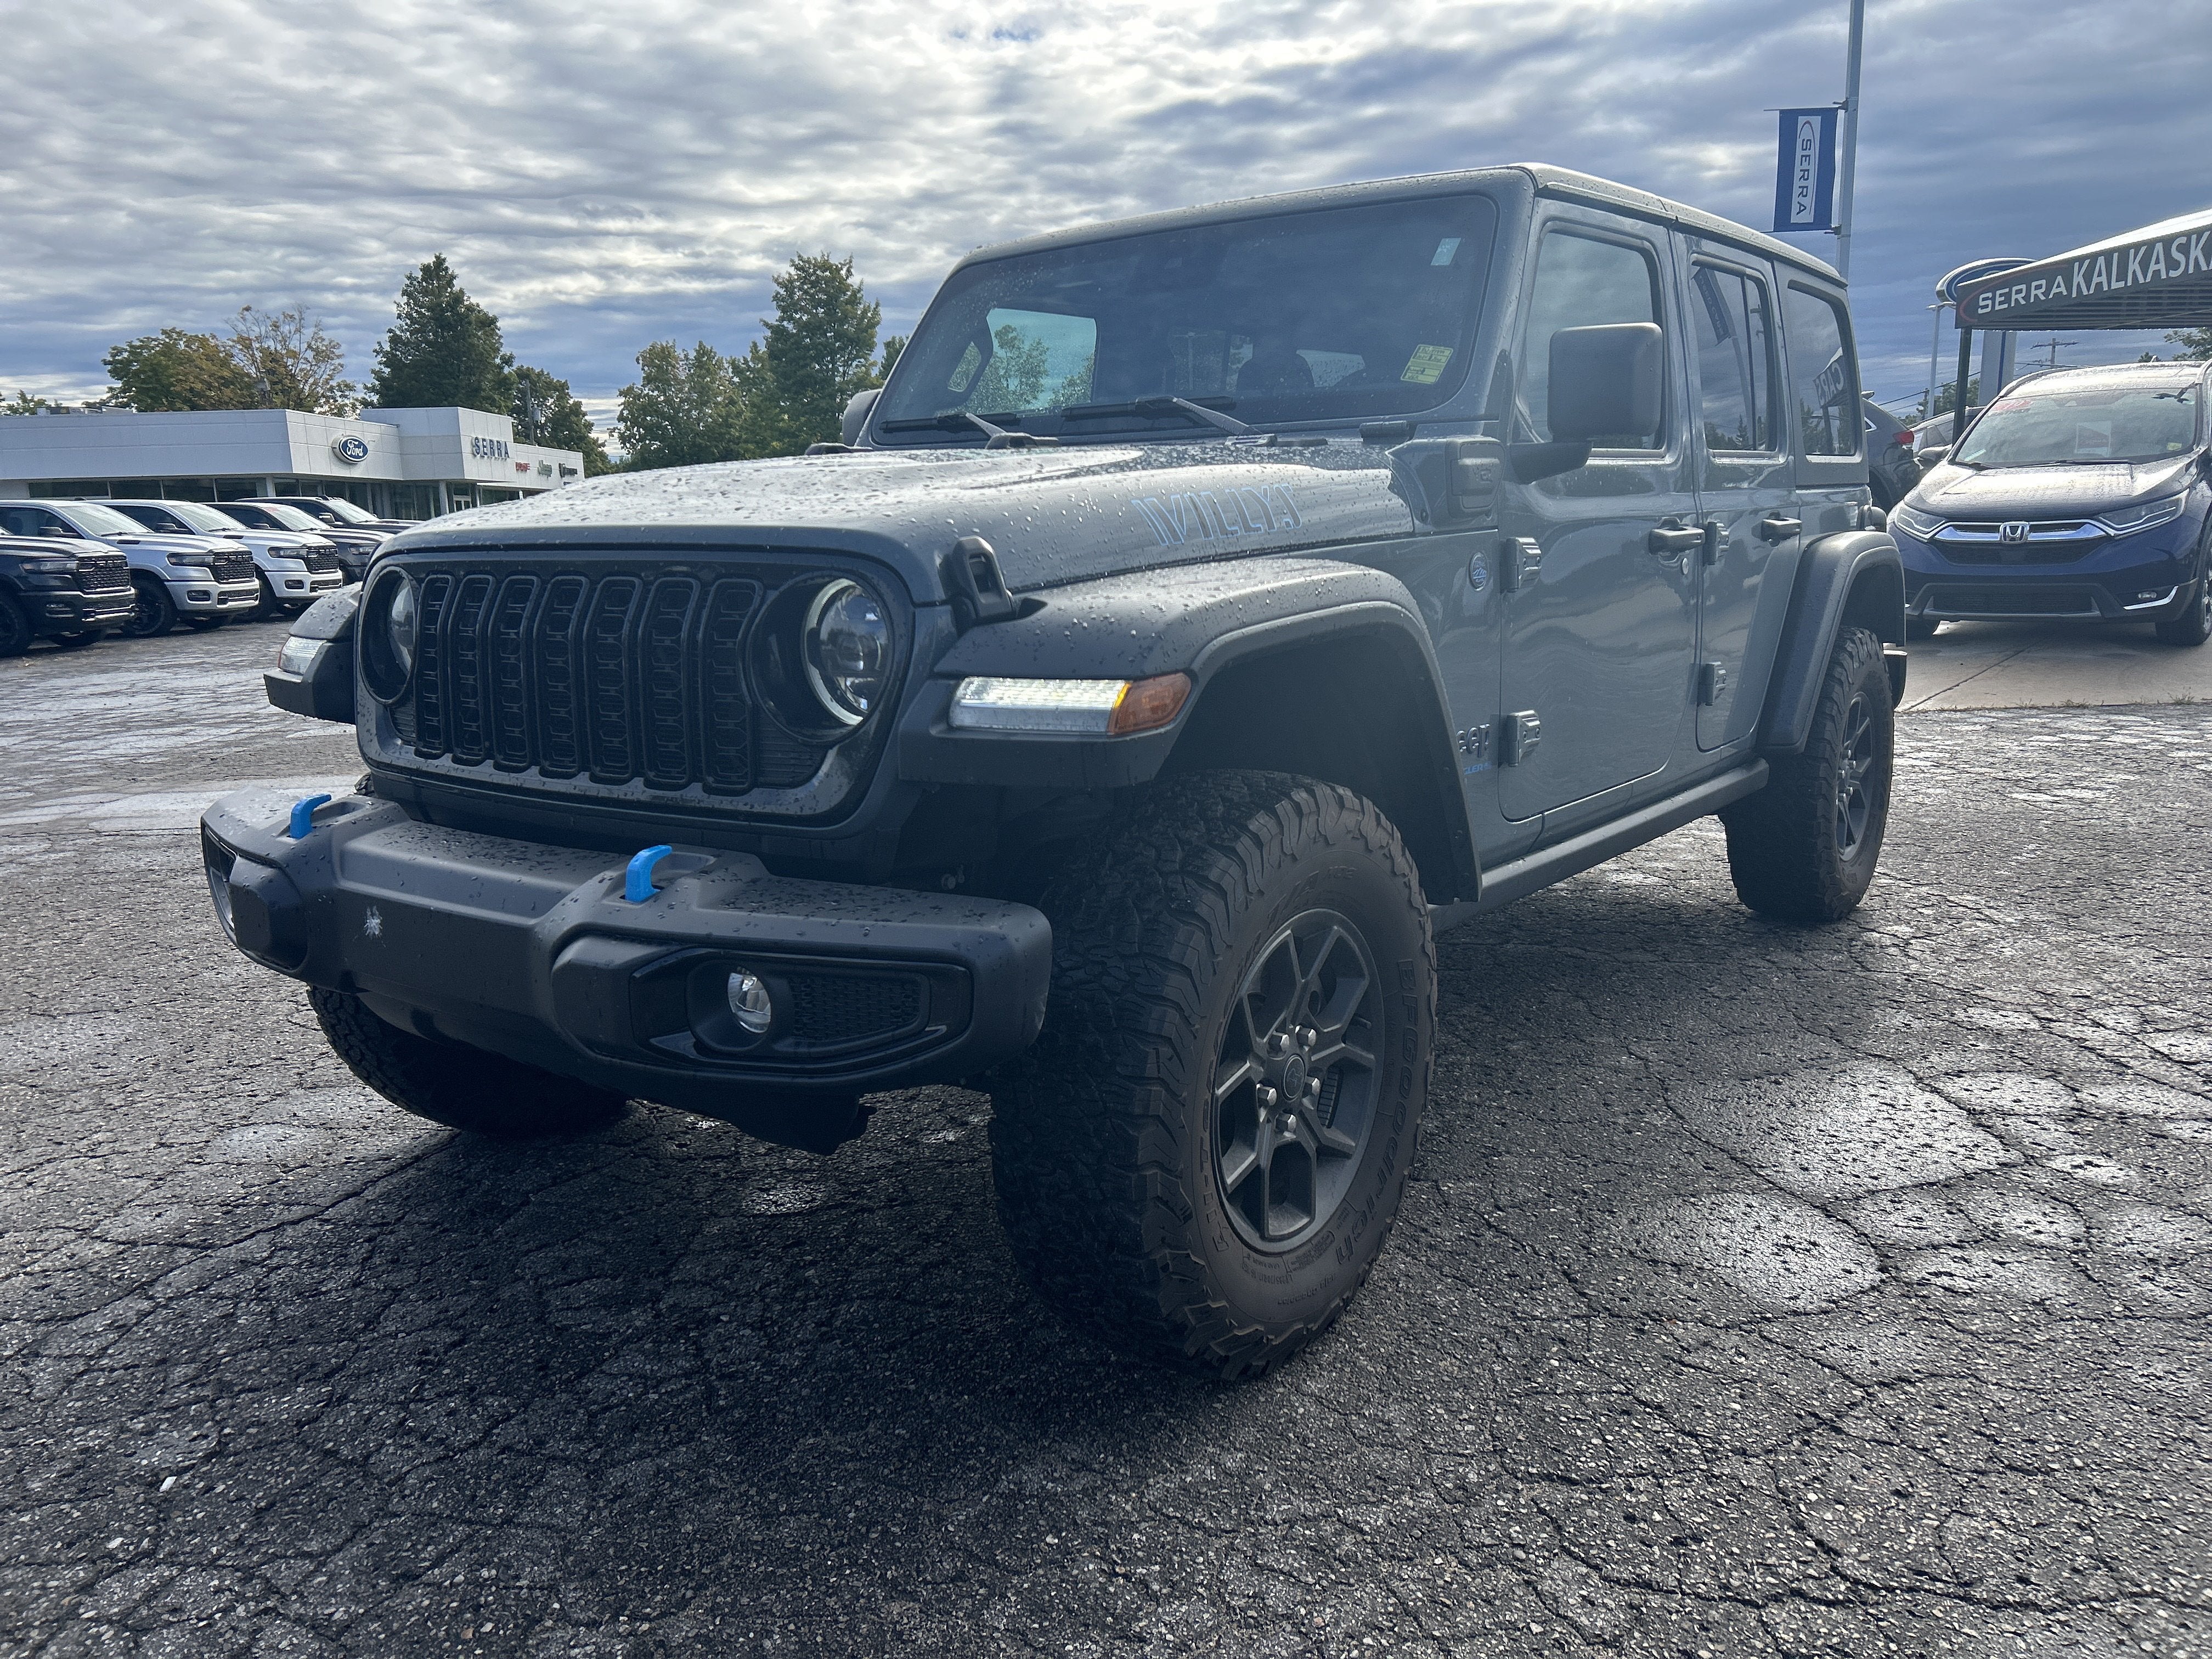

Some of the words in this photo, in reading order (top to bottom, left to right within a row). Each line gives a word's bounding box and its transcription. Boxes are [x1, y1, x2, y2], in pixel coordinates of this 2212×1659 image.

[1796, 138, 1812, 216] SERRA
[1978, 275, 2067, 314] SERRA
[2072, 230, 2212, 298] KALKASK
[347, 439, 364, 458] Ford
[475, 437, 510, 459] SERRA
[1456, 723, 1491, 758] eep
[1335, 960, 1419, 1265] BFGoodrich
